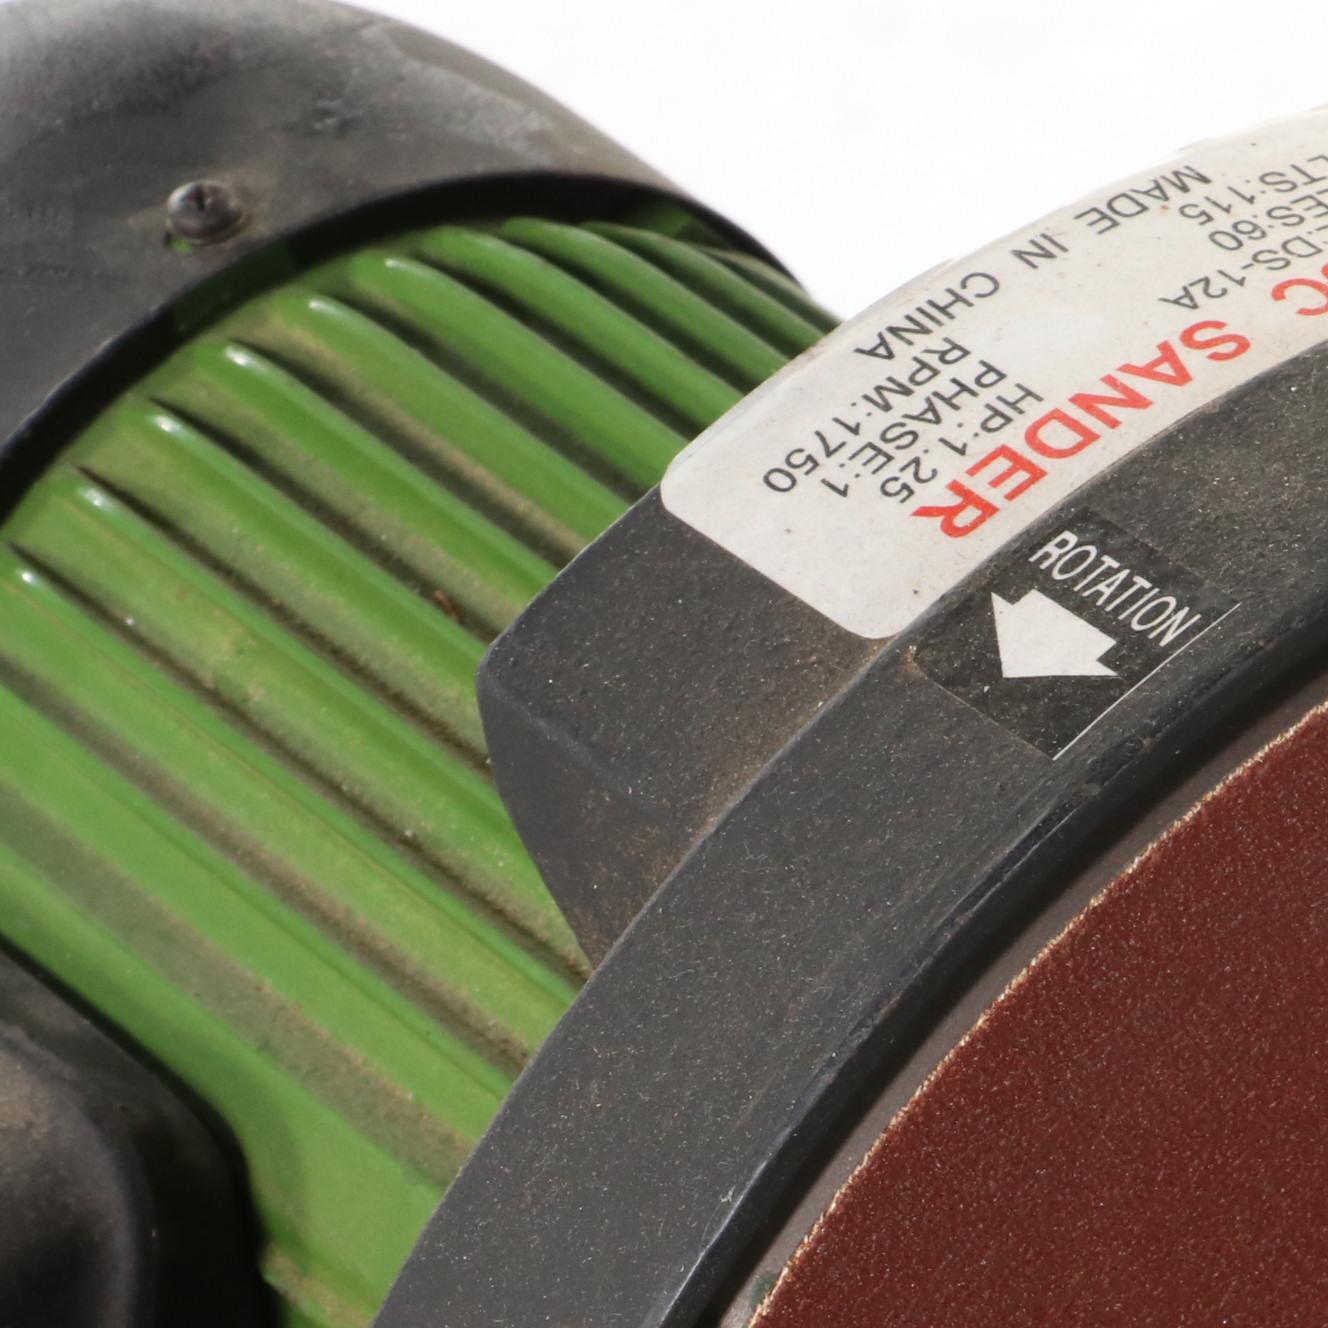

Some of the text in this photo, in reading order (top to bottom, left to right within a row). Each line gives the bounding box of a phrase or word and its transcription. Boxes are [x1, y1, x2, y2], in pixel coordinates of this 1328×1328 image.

[854, 165, 1212, 360] MADE IN CHINA
[763, 337, 971, 494] RPM:1750
[820, 360, 1007, 498] PHASE:1
[880, 383, 1044, 504] HP:1.25
[910, 320, 1251, 538] SANDER
[1028, 530, 1201, 648] ROTATION
